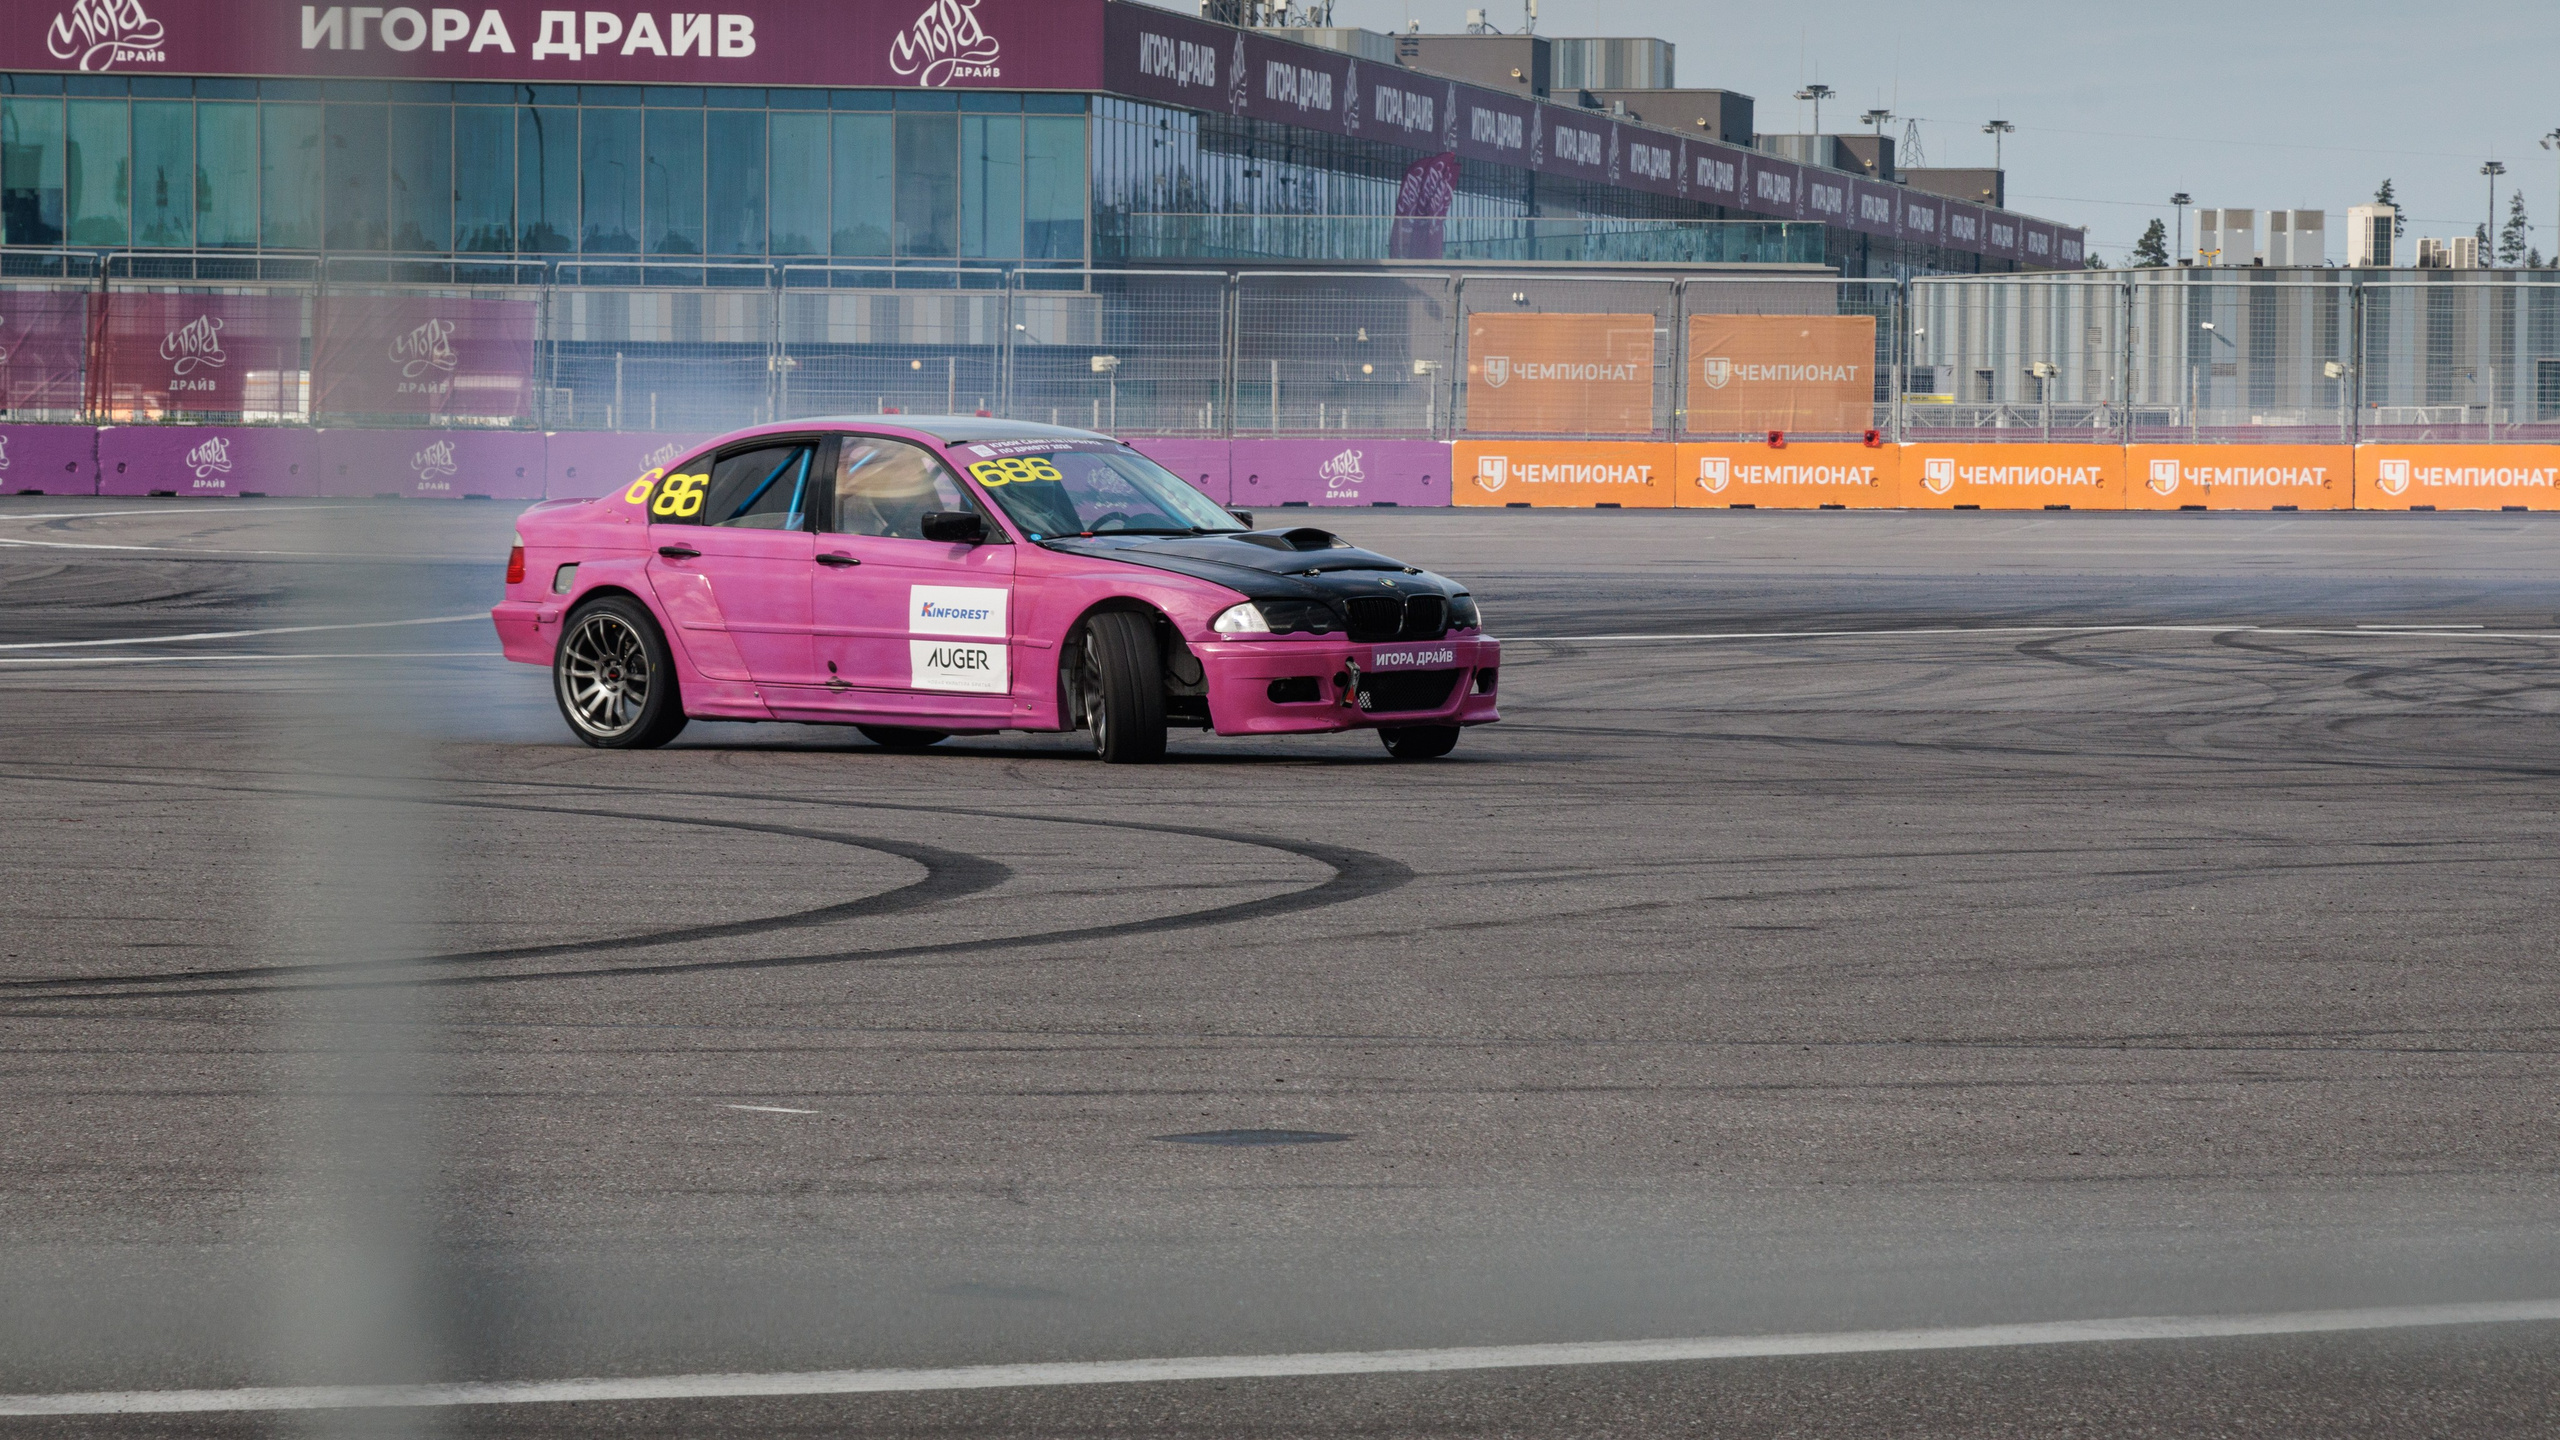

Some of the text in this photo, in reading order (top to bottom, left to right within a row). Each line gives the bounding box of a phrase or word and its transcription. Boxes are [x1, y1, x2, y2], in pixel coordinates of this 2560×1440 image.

[302, 6, 756, 61] ИГОРА ДРАЙВ
[116, 49, 166, 62] ДРАЙВ
[1140, 31, 1177, 80] ИГОРА
[1178, 40, 1216, 88] ДРАЙВ
[954, 65, 1001, 78] ДРАЙВ
[1266, 60, 1298, 104] ИГОРА
[1299, 67, 1332, 112] ДРАЙВ
[1376, 85, 1403, 124] ИГОРА
[1403, 91, 1434, 132] ДРАЙВ
[1513, 362, 1637, 382] ЧЕМПИОНАТ
[1734, 364, 1858, 382] ЧЕМПИОНАТ
[169, 379, 216, 391] ДРАЙВ
[397, 380, 448, 394] ДРАЙВ
[969, 457, 1063, 487] 686
[1512, 464, 1652, 484] ЧЕМПИОНАТ
[1733, 465, 1875, 485] ЧЕМПИОНАТ
[1959, 466, 2101, 486] ЧЕМПИОНАТ
[2184, 467, 2327, 487] ЧЕМПИОНАТ
[2414, 467, 2559, 487] ЧЕМПИОНАТ
[193, 478, 226, 489] ДРАЙВ
[417, 480, 450, 490] ДРАЙВ
[624, 467, 710, 517] 686
[1326, 489, 1359, 498] ДРАЙВ
[921, 602, 989, 620] KINFOREST
[927, 647, 990, 670] AUGER
[1376, 647, 1453, 666] ИГОРА ДРАЙВ
